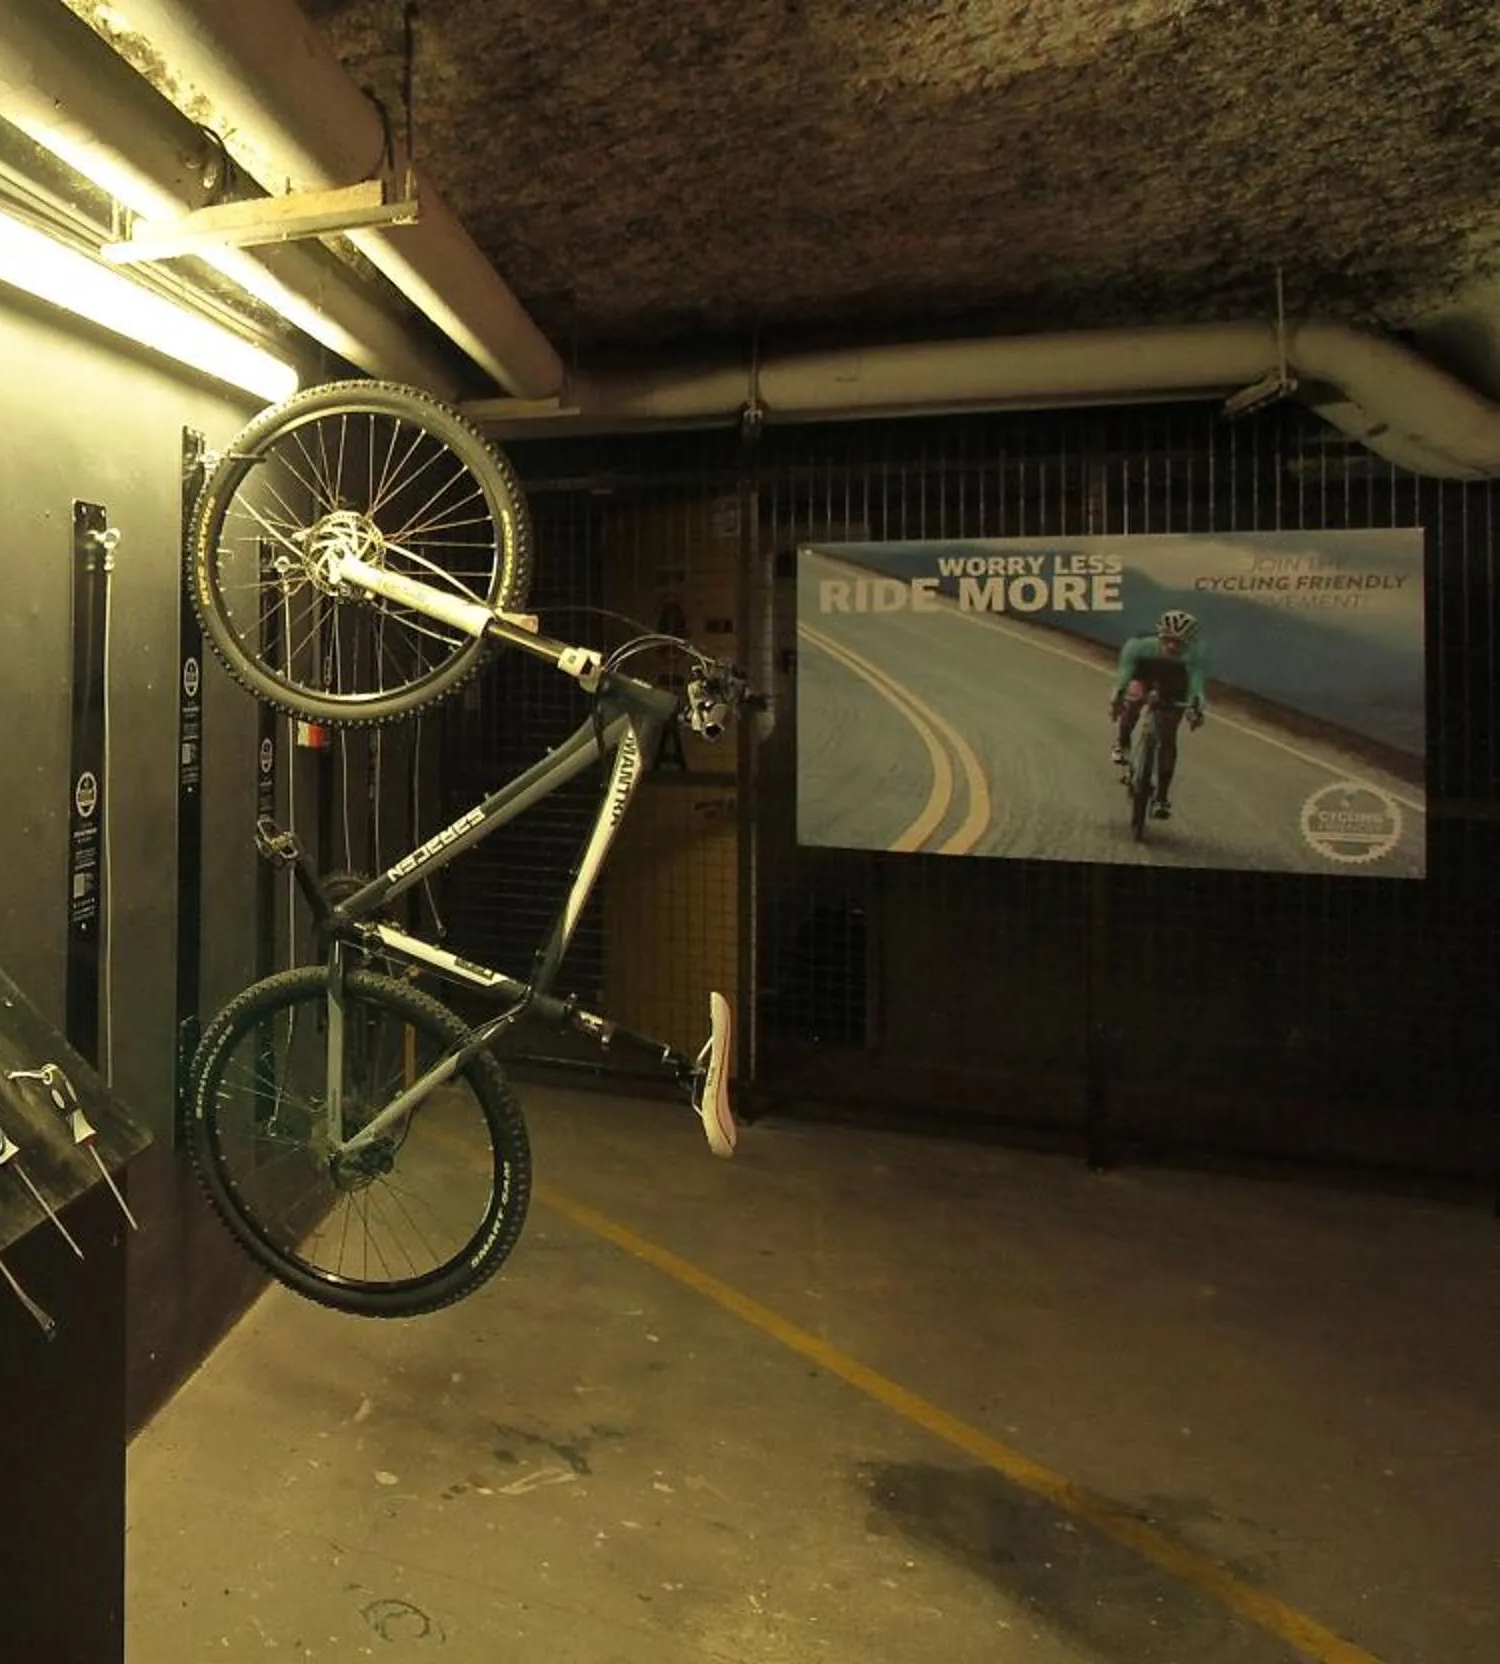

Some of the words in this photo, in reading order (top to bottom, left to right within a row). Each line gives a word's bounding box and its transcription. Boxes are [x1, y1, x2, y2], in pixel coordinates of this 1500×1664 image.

[938, 555, 1045, 577] WORRY
[1054, 554, 1123, 575] LESS
[819, 577, 940, 613] RIDE
[959, 575, 1124, 613] MORE
[1195, 575, 1290, 591] CYCLING
[1296, 574, 1407, 591] FRIENDLY
